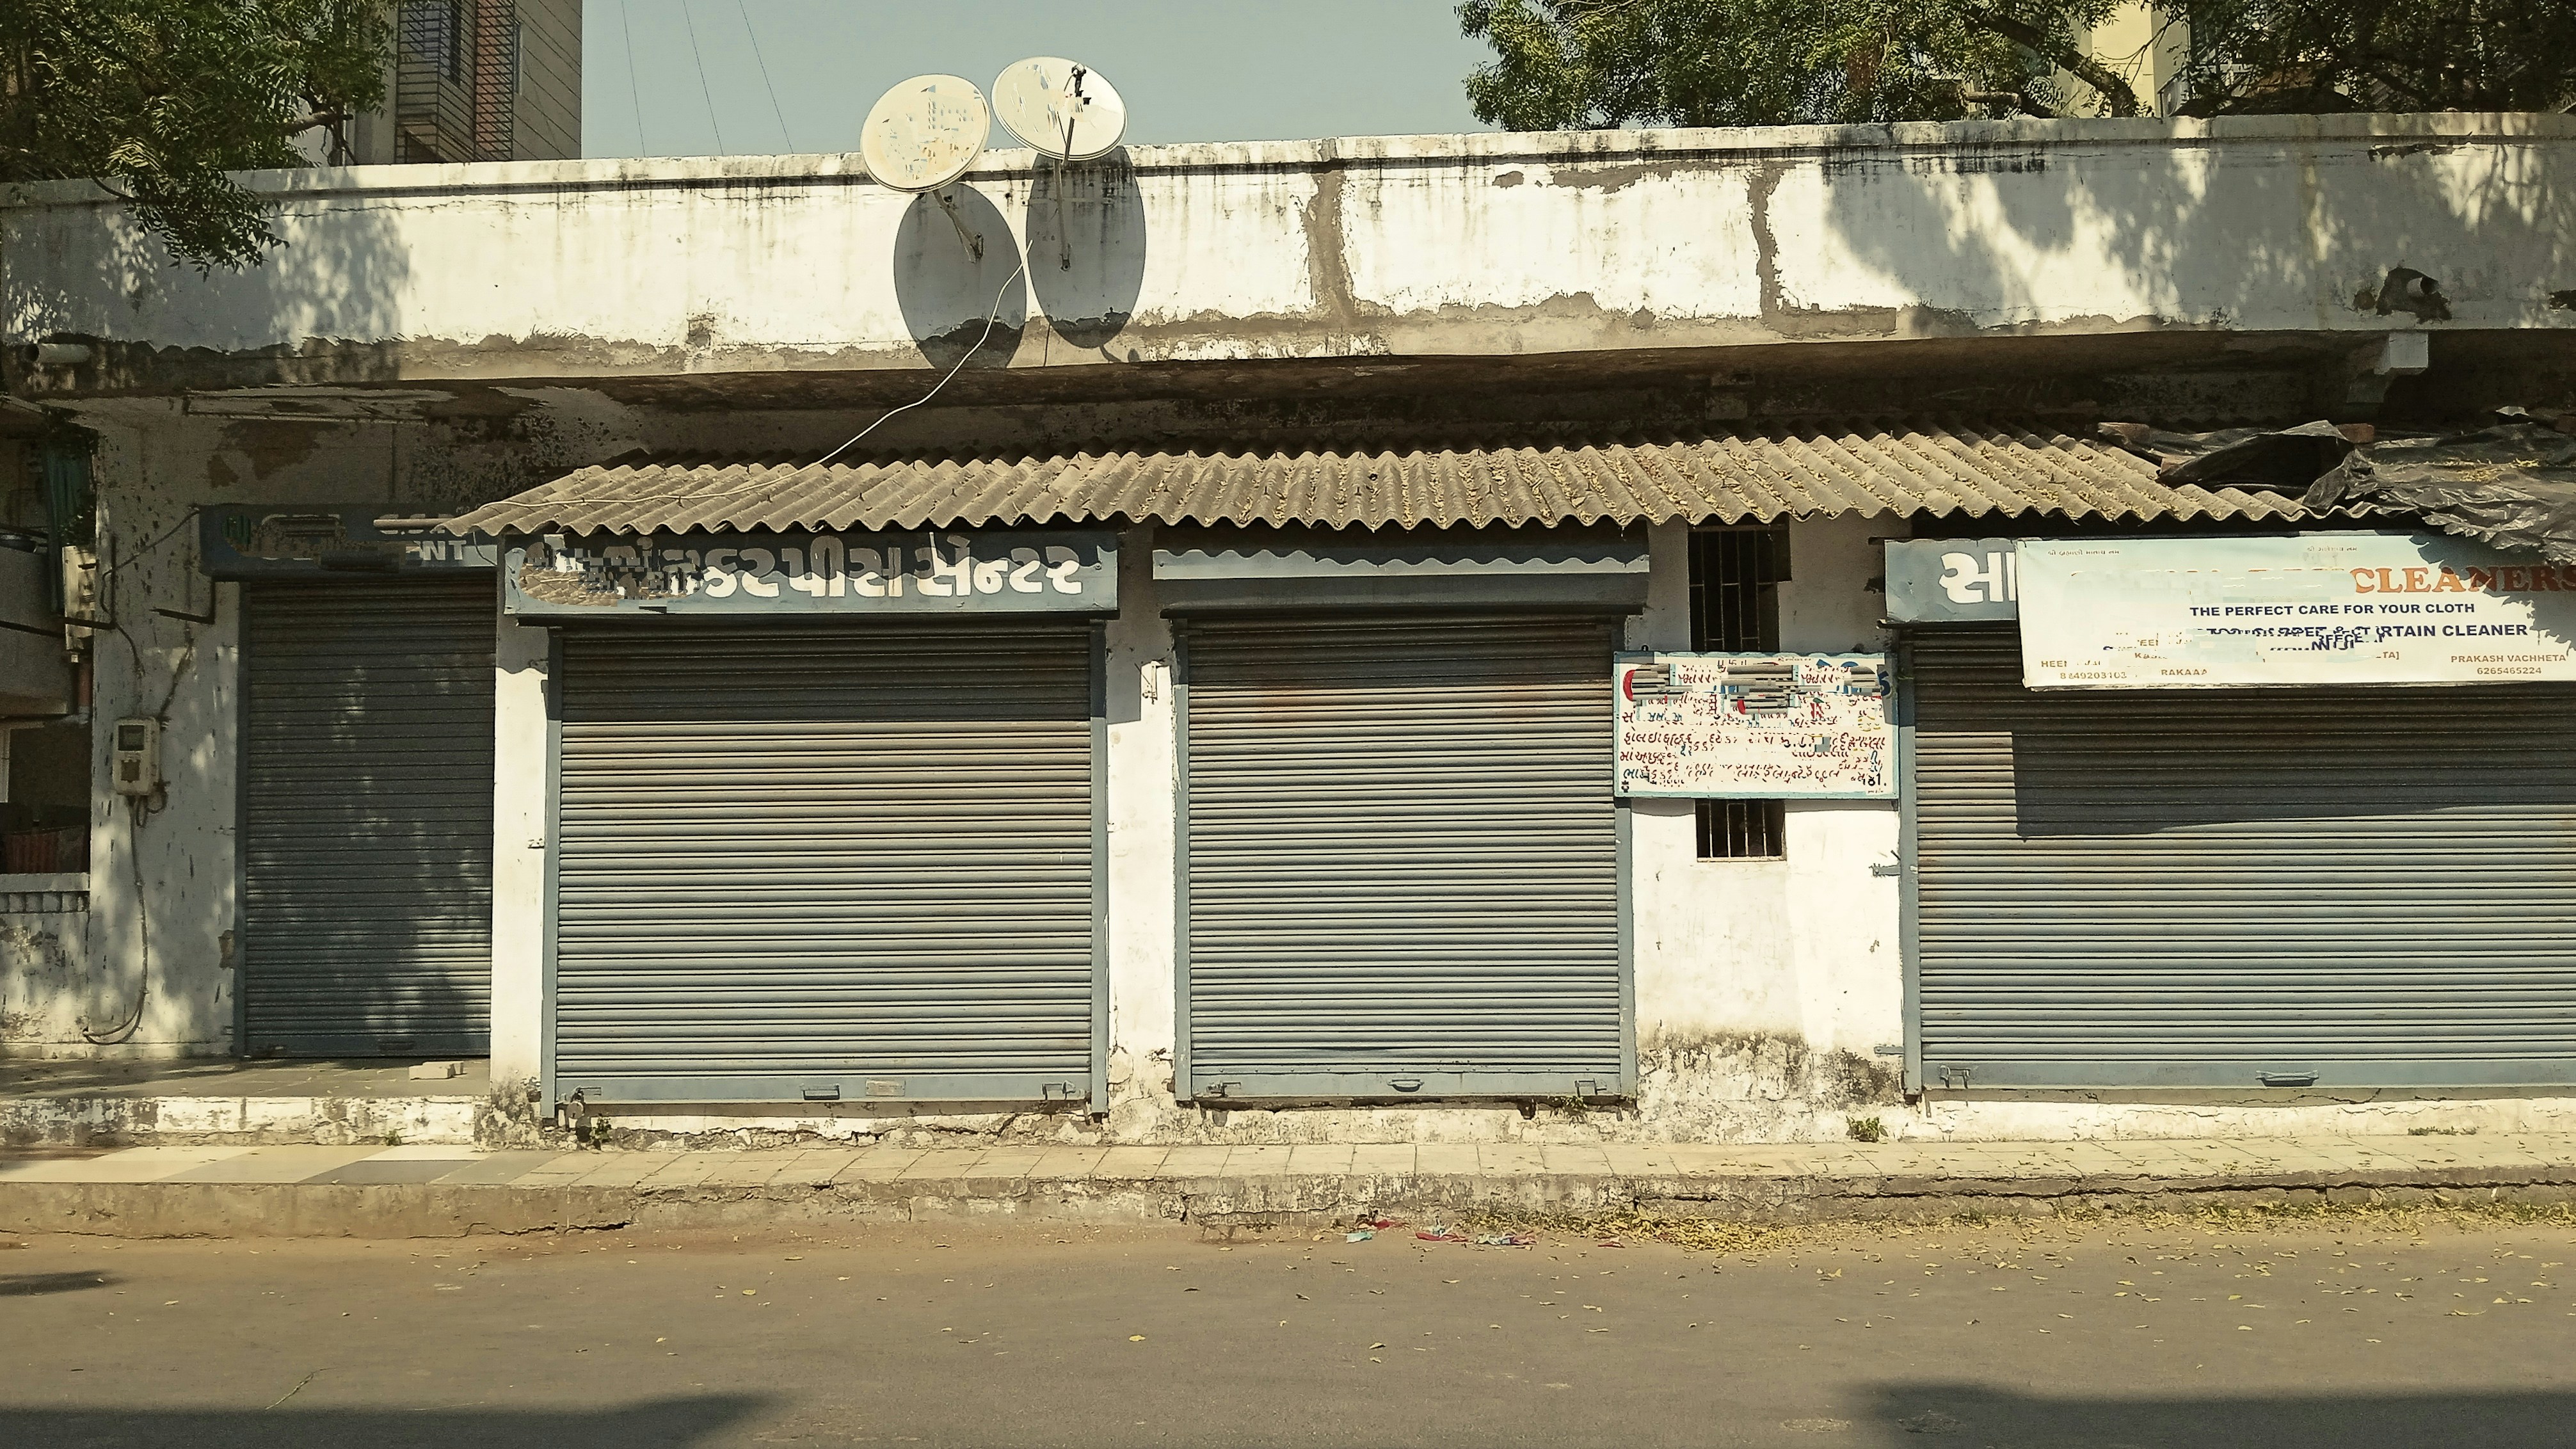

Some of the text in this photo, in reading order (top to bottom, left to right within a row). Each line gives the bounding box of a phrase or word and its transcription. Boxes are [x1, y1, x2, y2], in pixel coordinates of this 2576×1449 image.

[2189, 604, 2475, 616] THE PERFECT CARE FOR YOUR CLOTH
[2442, 624, 2528, 636] CLEANER
[2451, 655, 2504, 663] PRAKASH
